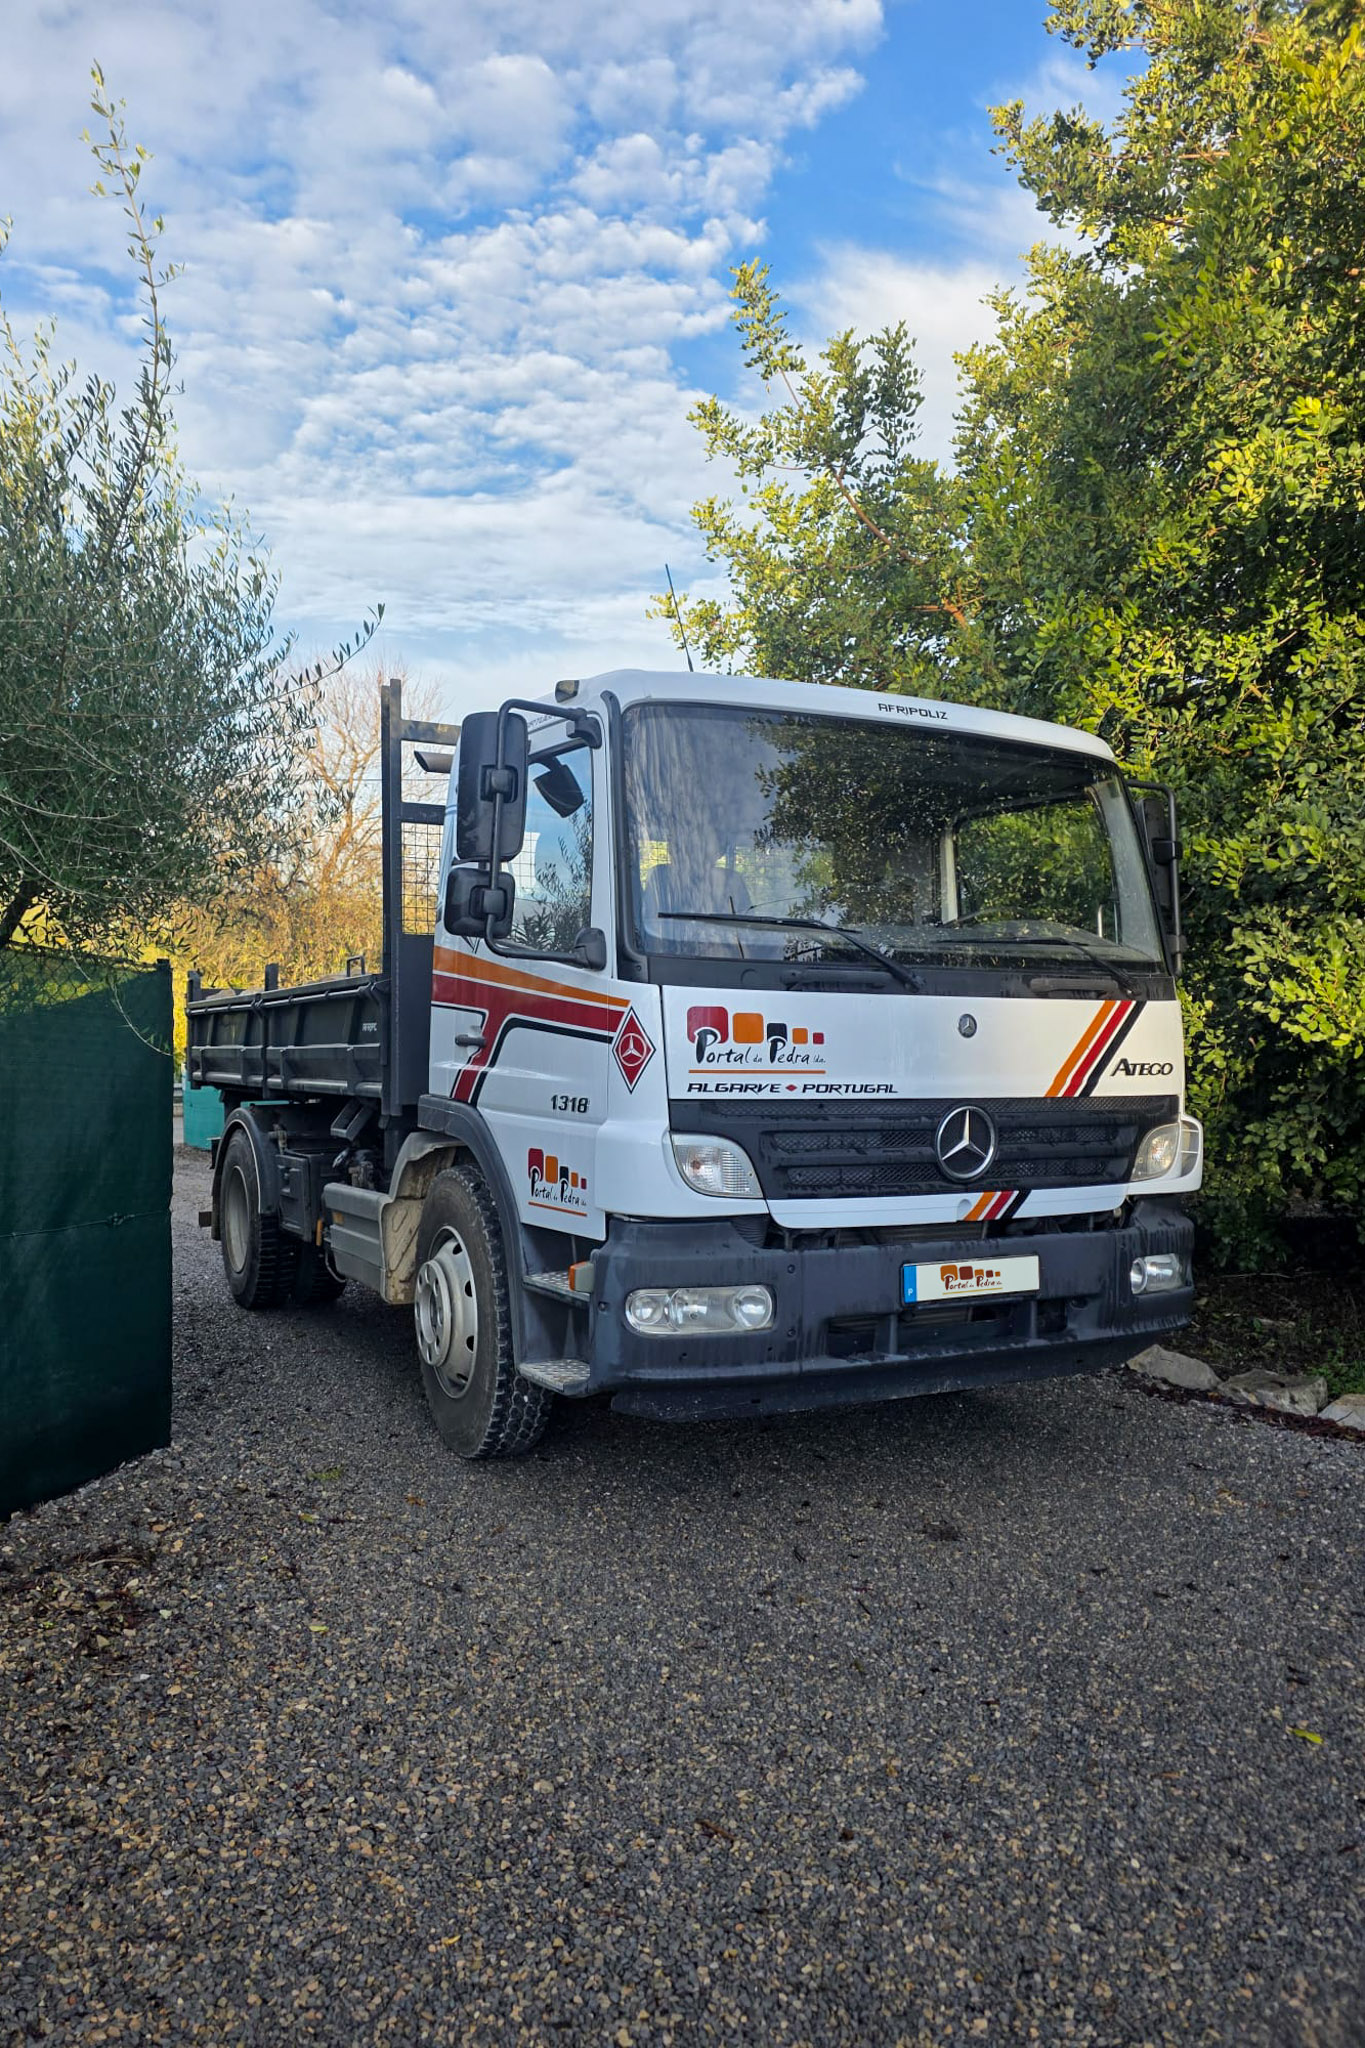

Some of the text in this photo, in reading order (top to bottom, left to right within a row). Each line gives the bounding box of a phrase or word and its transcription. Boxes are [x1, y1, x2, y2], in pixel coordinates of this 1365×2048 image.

[878, 703, 948, 720] AFRIPOLIZ
[696, 1028, 752, 1064] Portal
[769, 1037, 810, 1064] Pedra
[687, 1083, 898, 1096] ALGARVE PORTUGAL
[550, 1095, 590, 1114] 1318
[531, 1167, 580, 1206] Portal Pedra
[945, 1275, 969, 1291] Portal
[976, 1275, 996, 1287] Pedra
[907, 1288, 913, 1297] P
